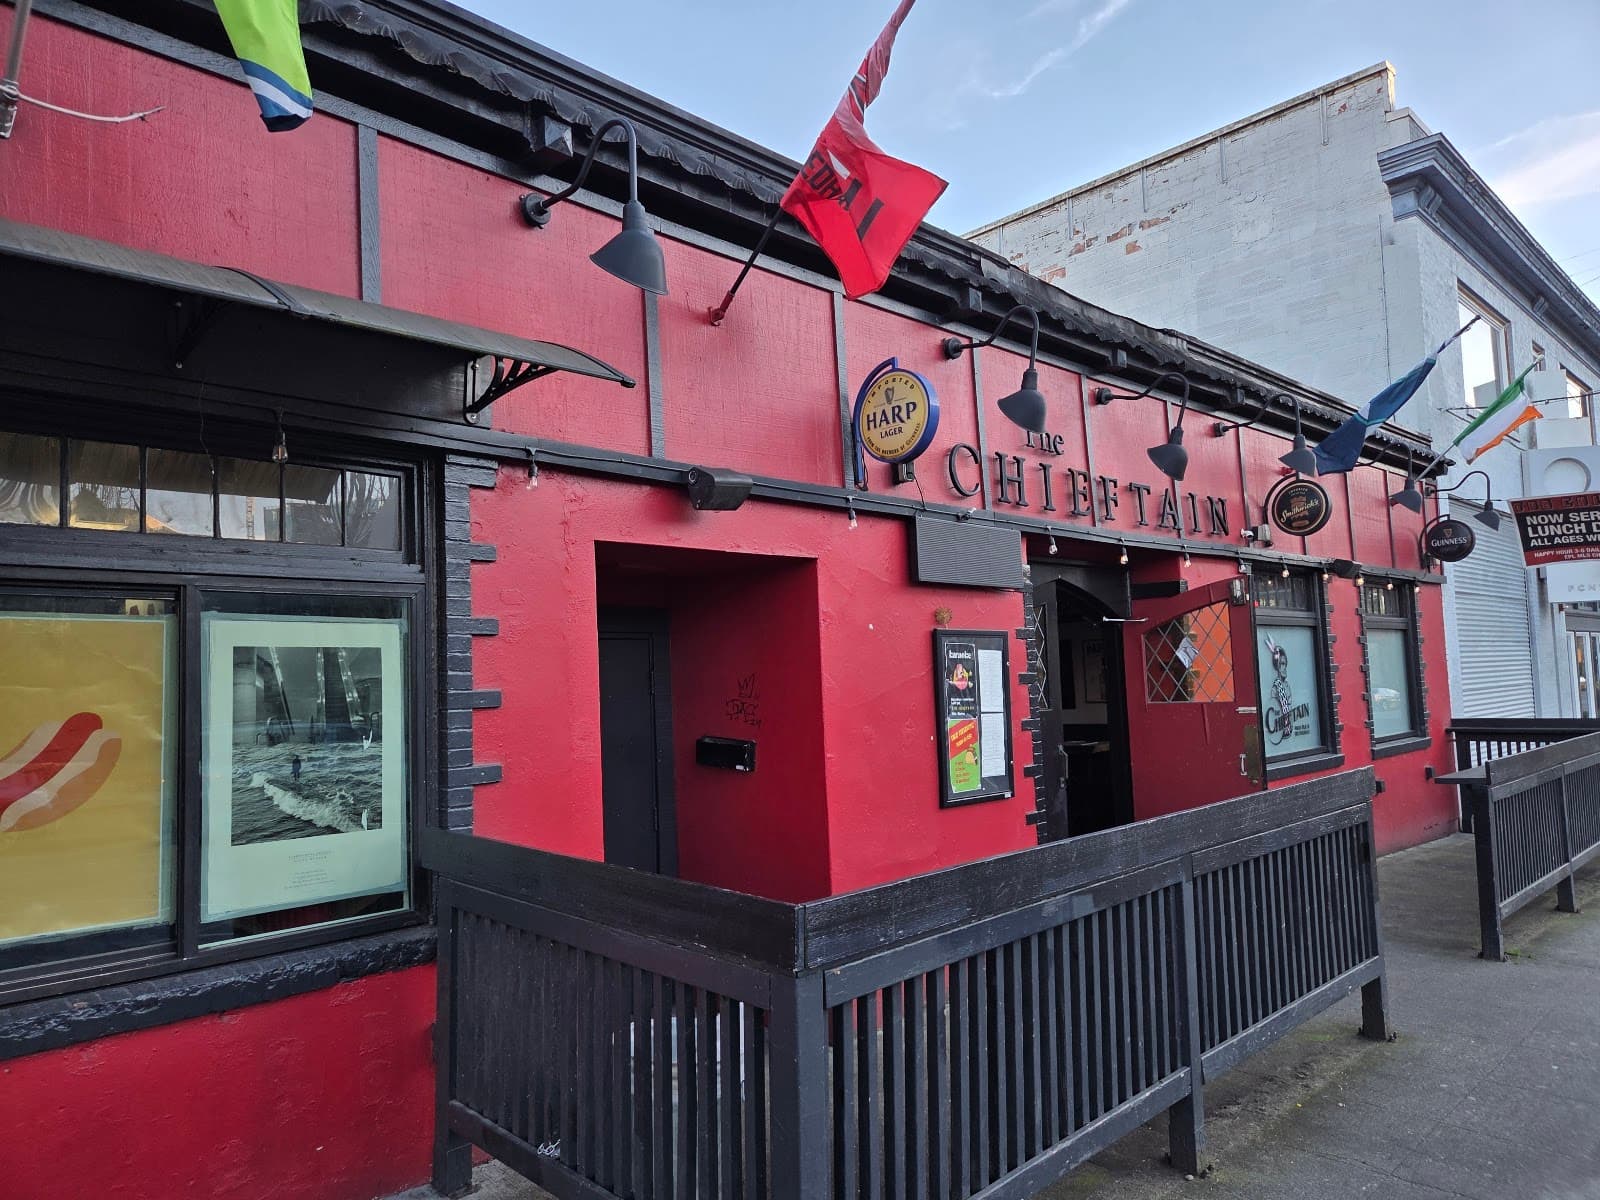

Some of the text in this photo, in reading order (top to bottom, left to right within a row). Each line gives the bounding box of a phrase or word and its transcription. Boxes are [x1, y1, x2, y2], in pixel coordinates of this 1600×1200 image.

[866, 401, 917, 431] HARP
[880, 426, 904, 439] LAGER
[949, 442, 1229, 536] CHIEFTAIN
[1526, 513, 1564, 526] NOW
[1527, 522, 1587, 538] LUNCH
[1431, 536, 1468, 547] GUINNESS
[1530, 537, 1552, 547] ALL
[1553, 534, 1585, 545] AGES
[1534, 550, 1555, 558] HAPPY
